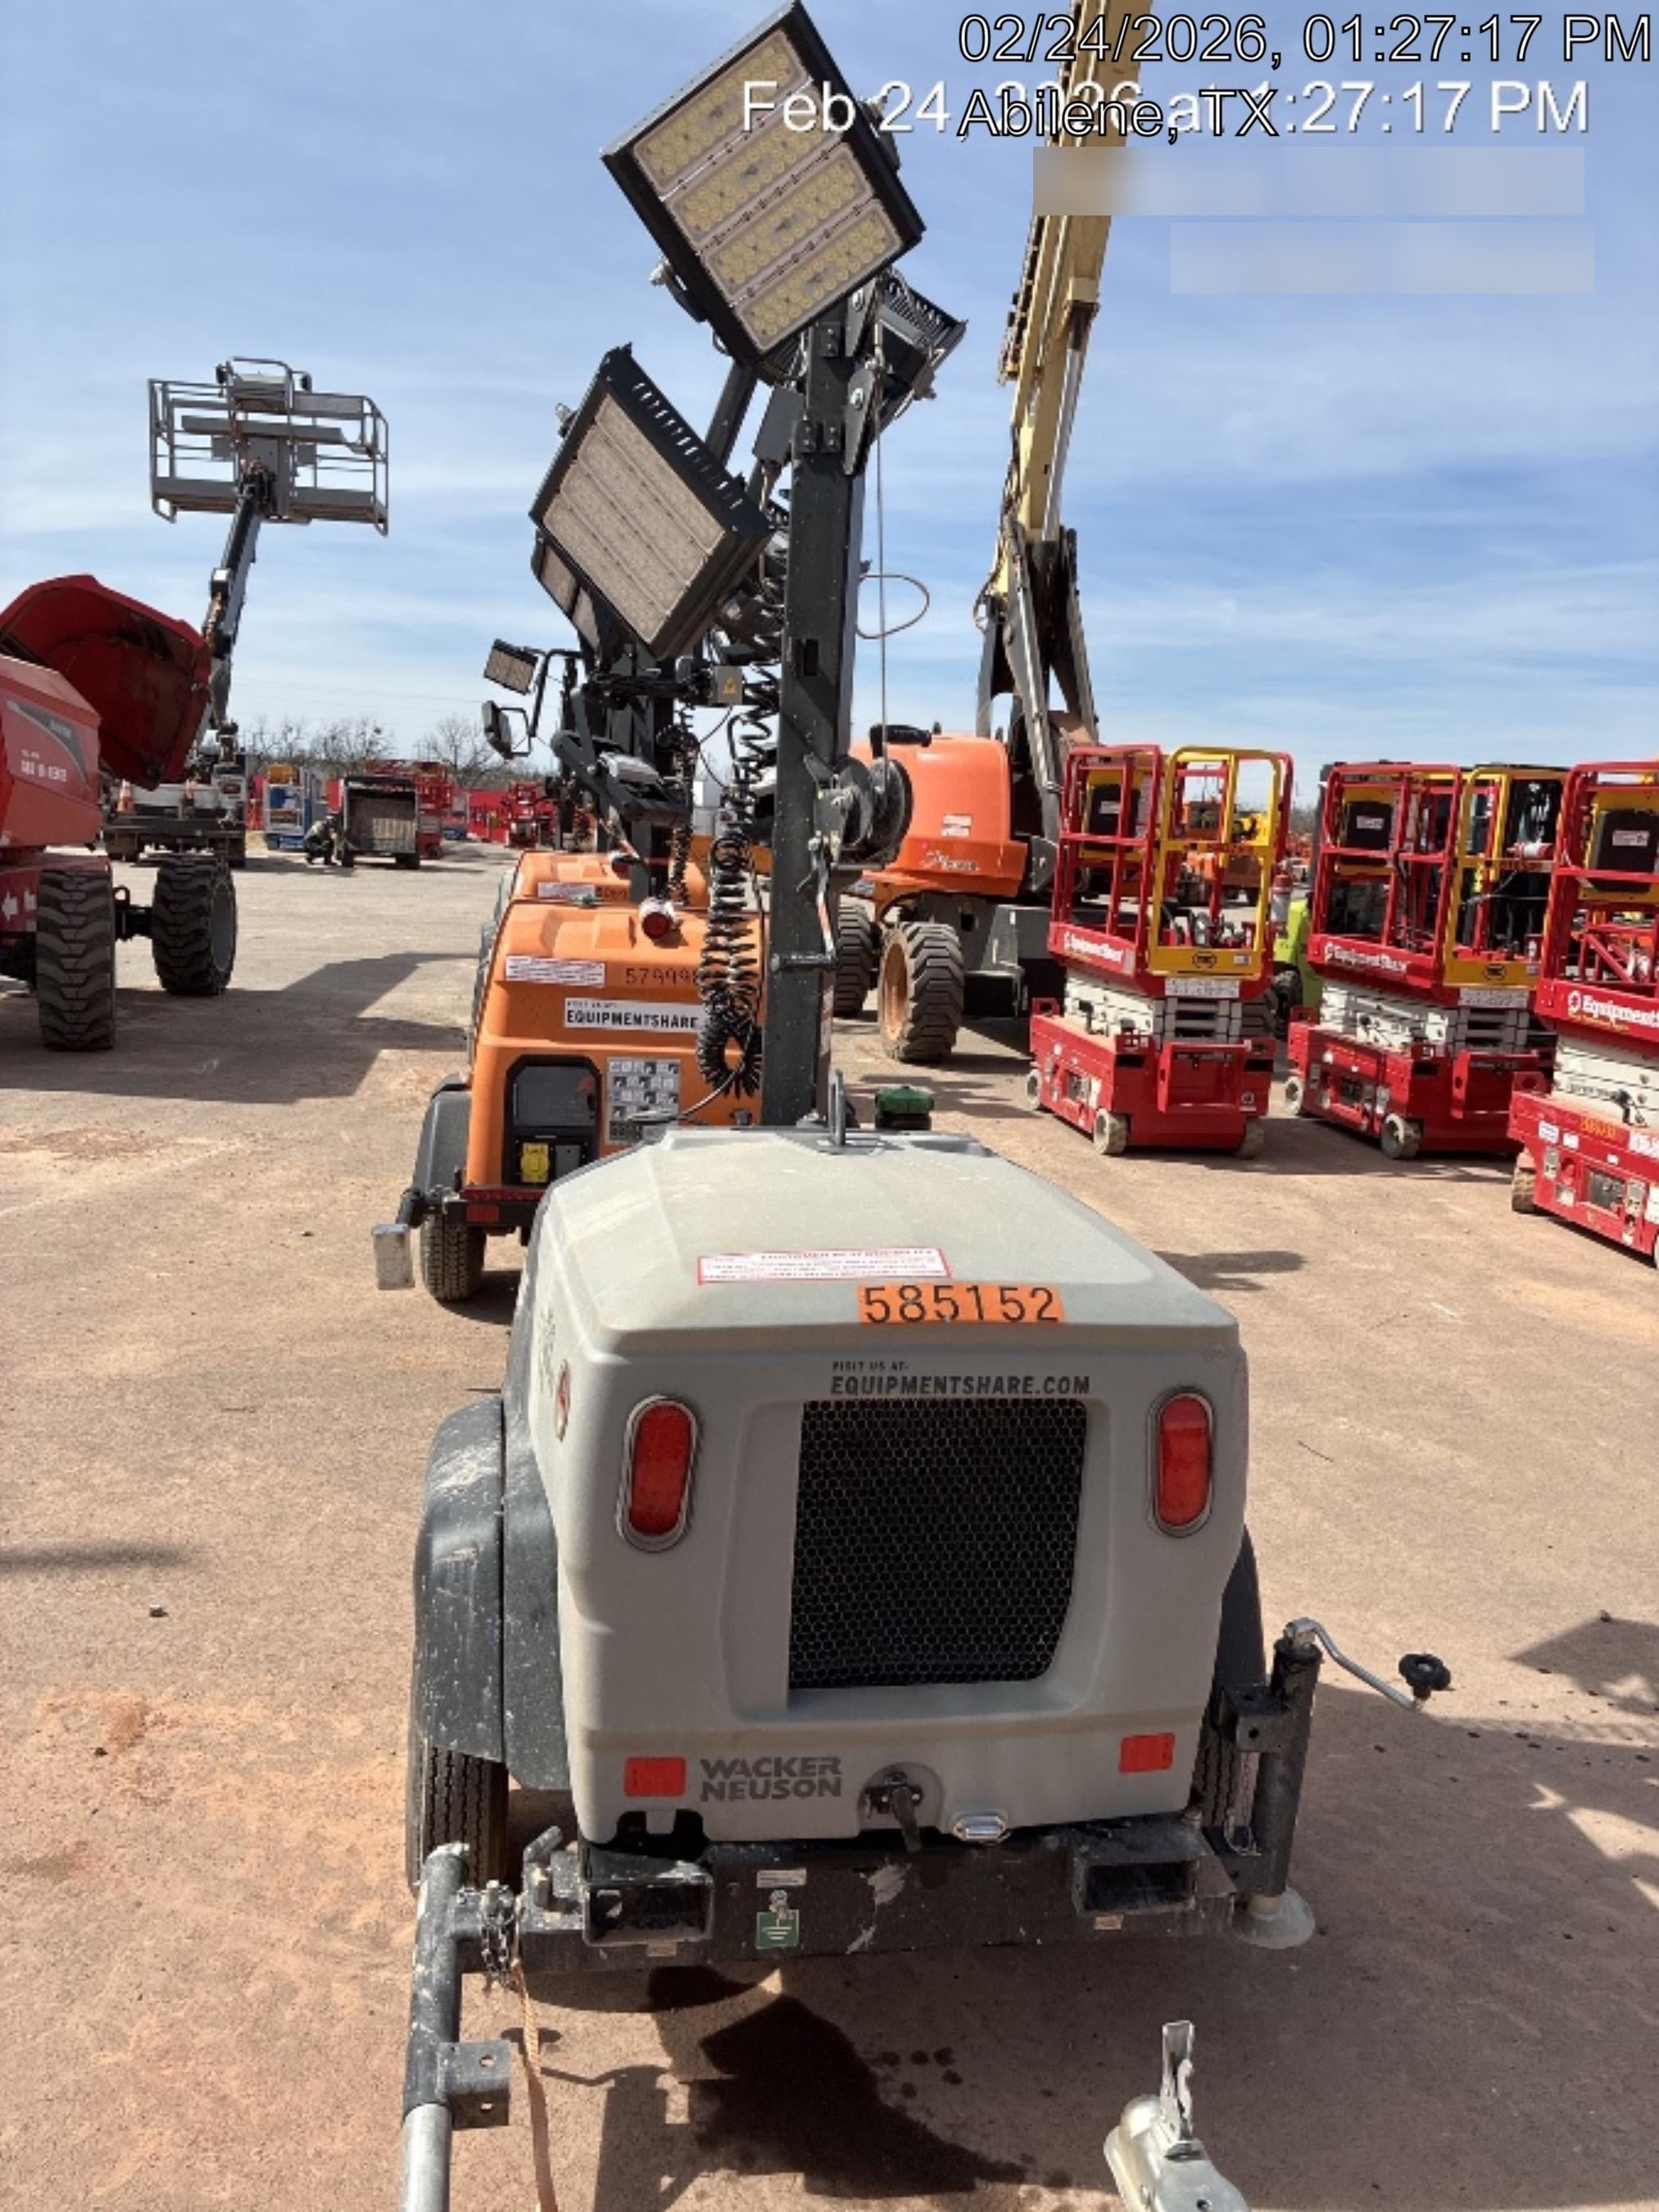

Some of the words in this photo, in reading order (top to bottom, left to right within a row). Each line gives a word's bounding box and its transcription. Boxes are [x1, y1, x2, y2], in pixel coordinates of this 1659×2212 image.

[864, 1284, 1058, 1324] 585152
[832, 1361, 864, 1371] VISIT
[869, 1361, 886, 1371] US
[831, 1375, 1090, 1395] EQUIPMENTSHARE.COM
[700, 1756, 842, 1779] WACKER
[700, 1777, 842, 1802] NEUSON
